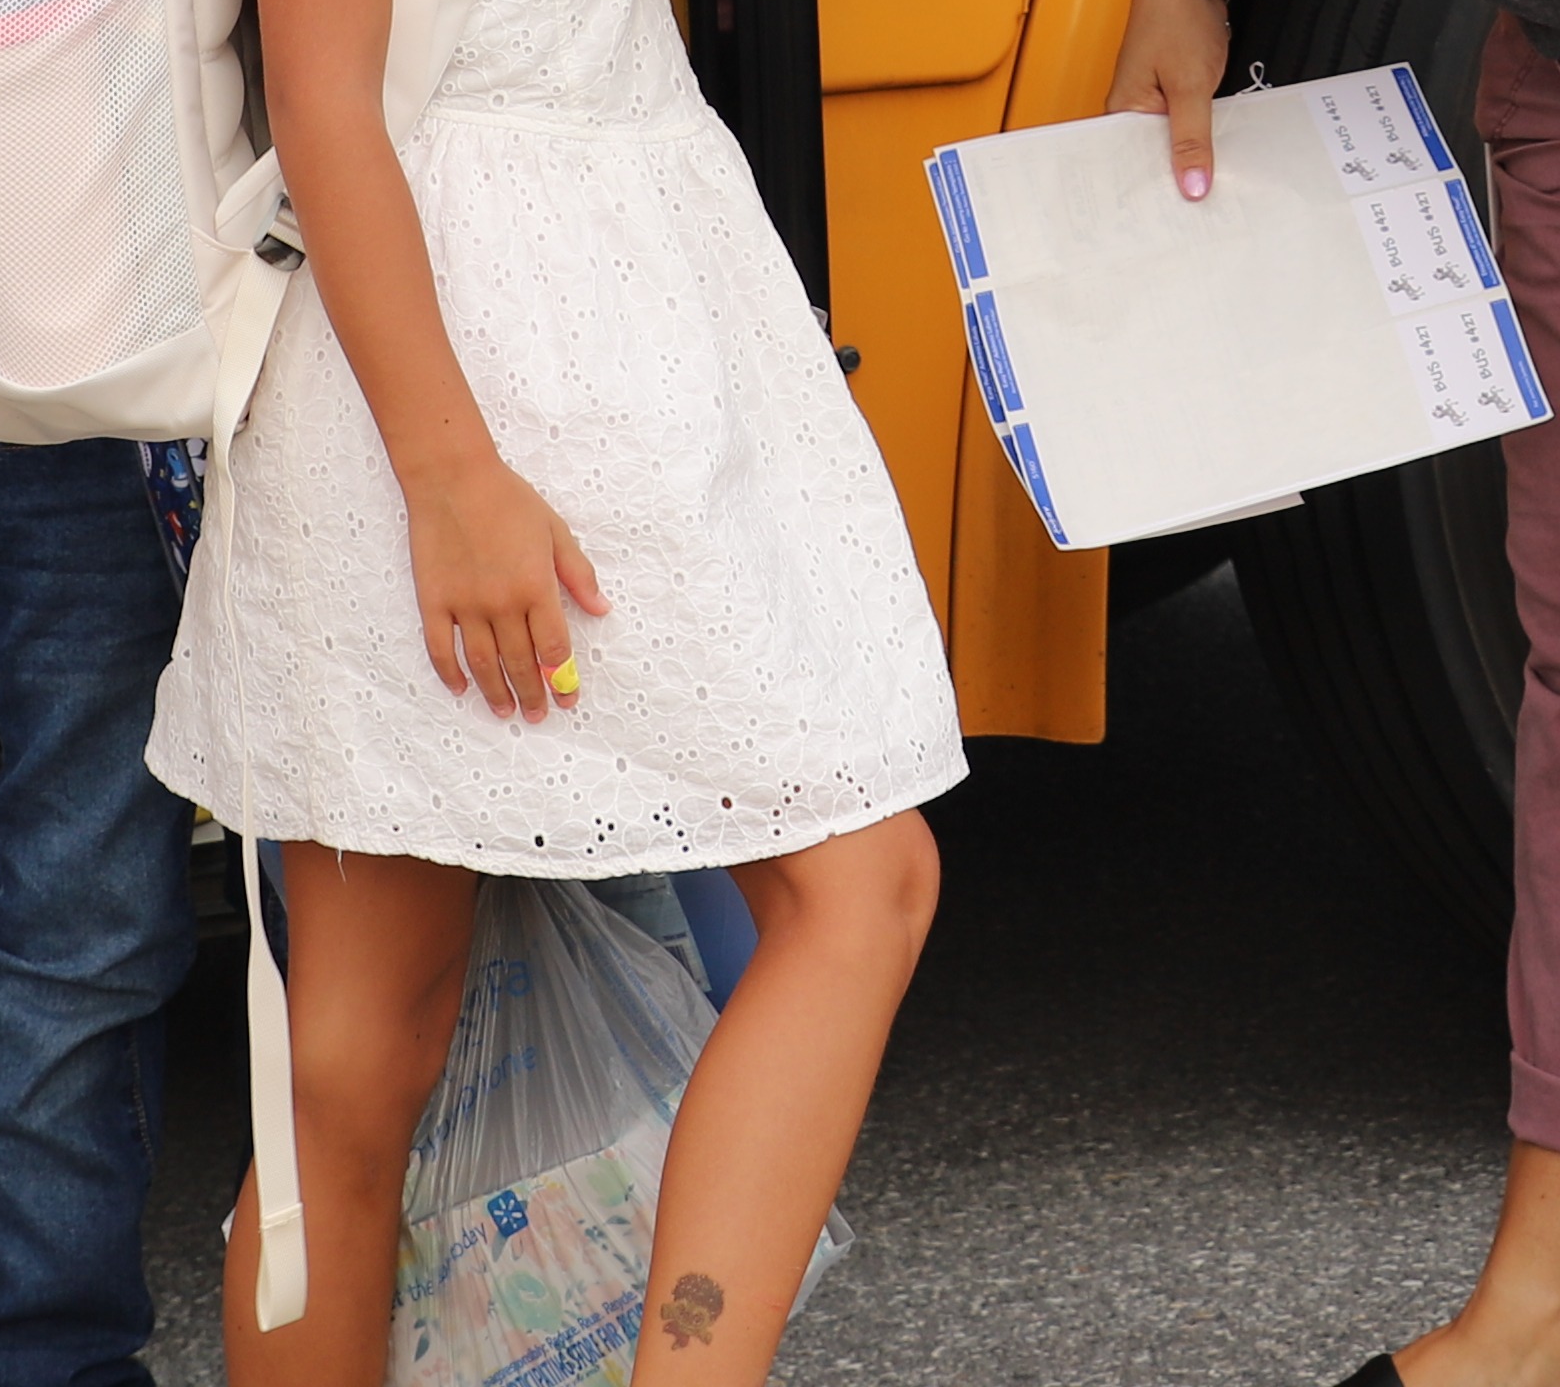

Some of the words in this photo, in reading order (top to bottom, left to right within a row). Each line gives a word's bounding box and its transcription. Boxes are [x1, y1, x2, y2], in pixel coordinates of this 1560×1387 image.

[1321, 95, 1340, 122] #427
[1365, 85, 1385, 112] #427
[1334, 125, 1355, 152] BUS
[1379, 115, 1399, 142] BUS
[1370, 202, 1390, 234] #427
[1415, 191, 1434, 222] #427
[1382, 236, 1402, 268] BUS
[1427, 225, 1447, 256] BUS
[1415, 325, 1435, 357] #427
[1460, 312, 1480, 344] #427
[1427, 360, 1447, 393] BUS
[1472, 347, 1493, 380] BUS
